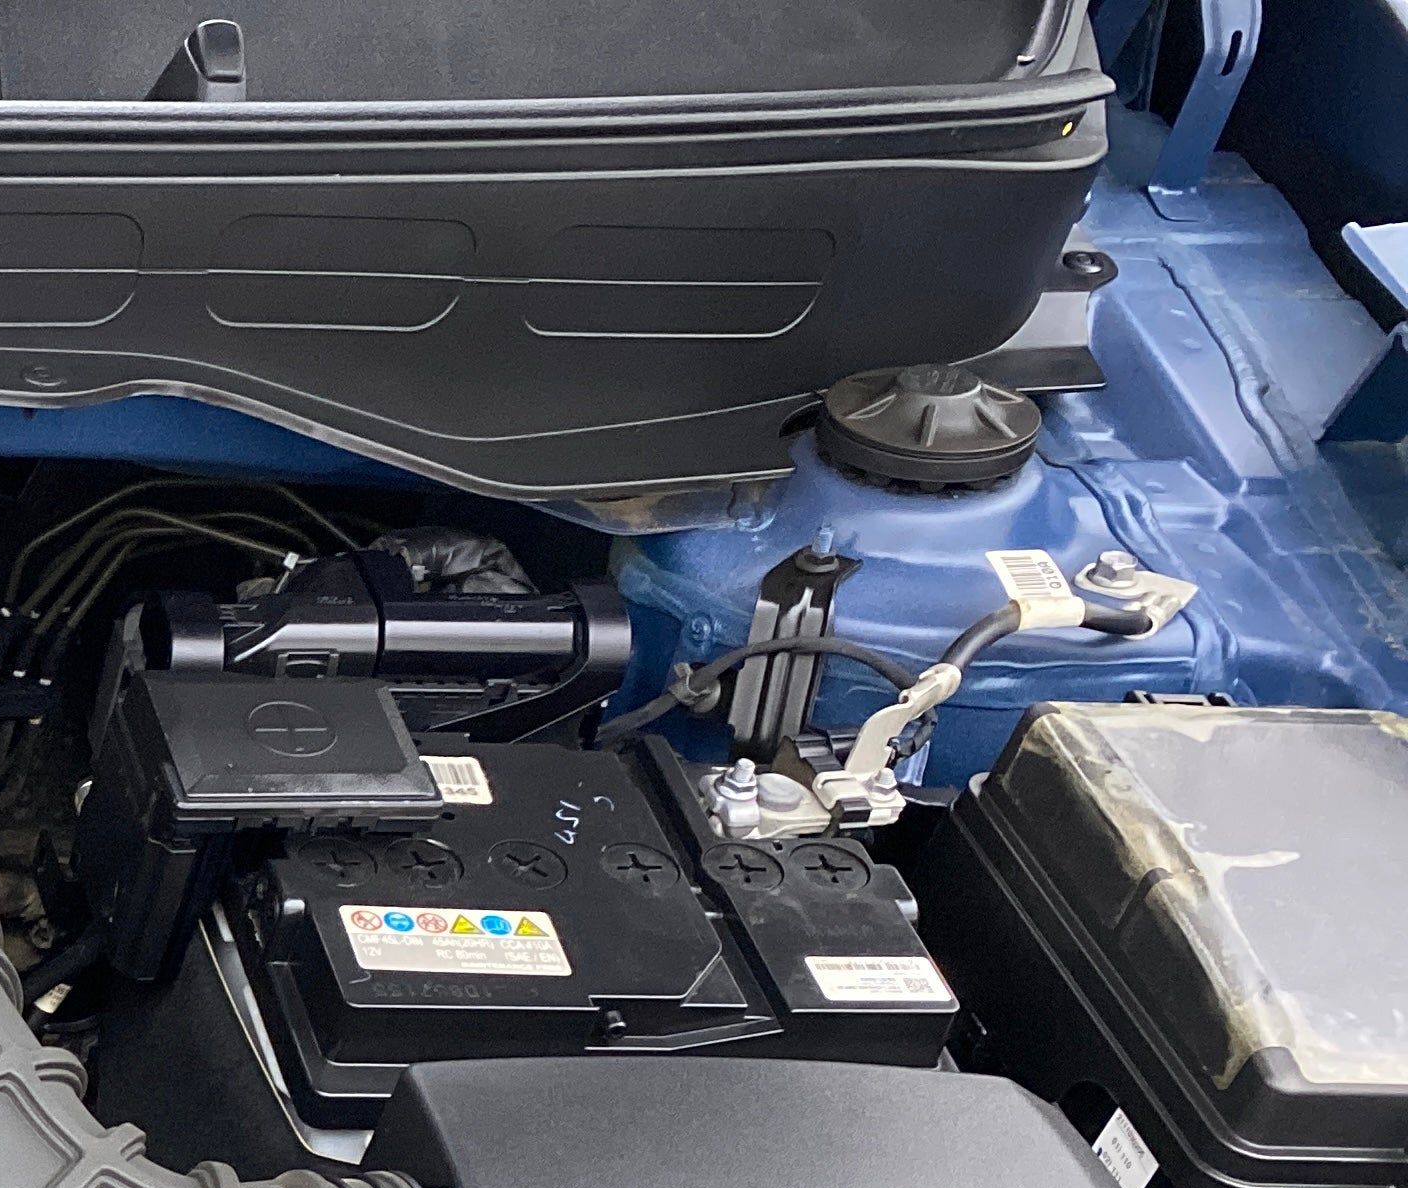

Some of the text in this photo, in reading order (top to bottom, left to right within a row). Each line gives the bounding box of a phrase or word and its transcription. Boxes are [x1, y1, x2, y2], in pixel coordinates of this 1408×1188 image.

[499, 939, 522, 950] CCA
[362, 946, 383, 957] 12V
[436, 950, 454, 960] RC
